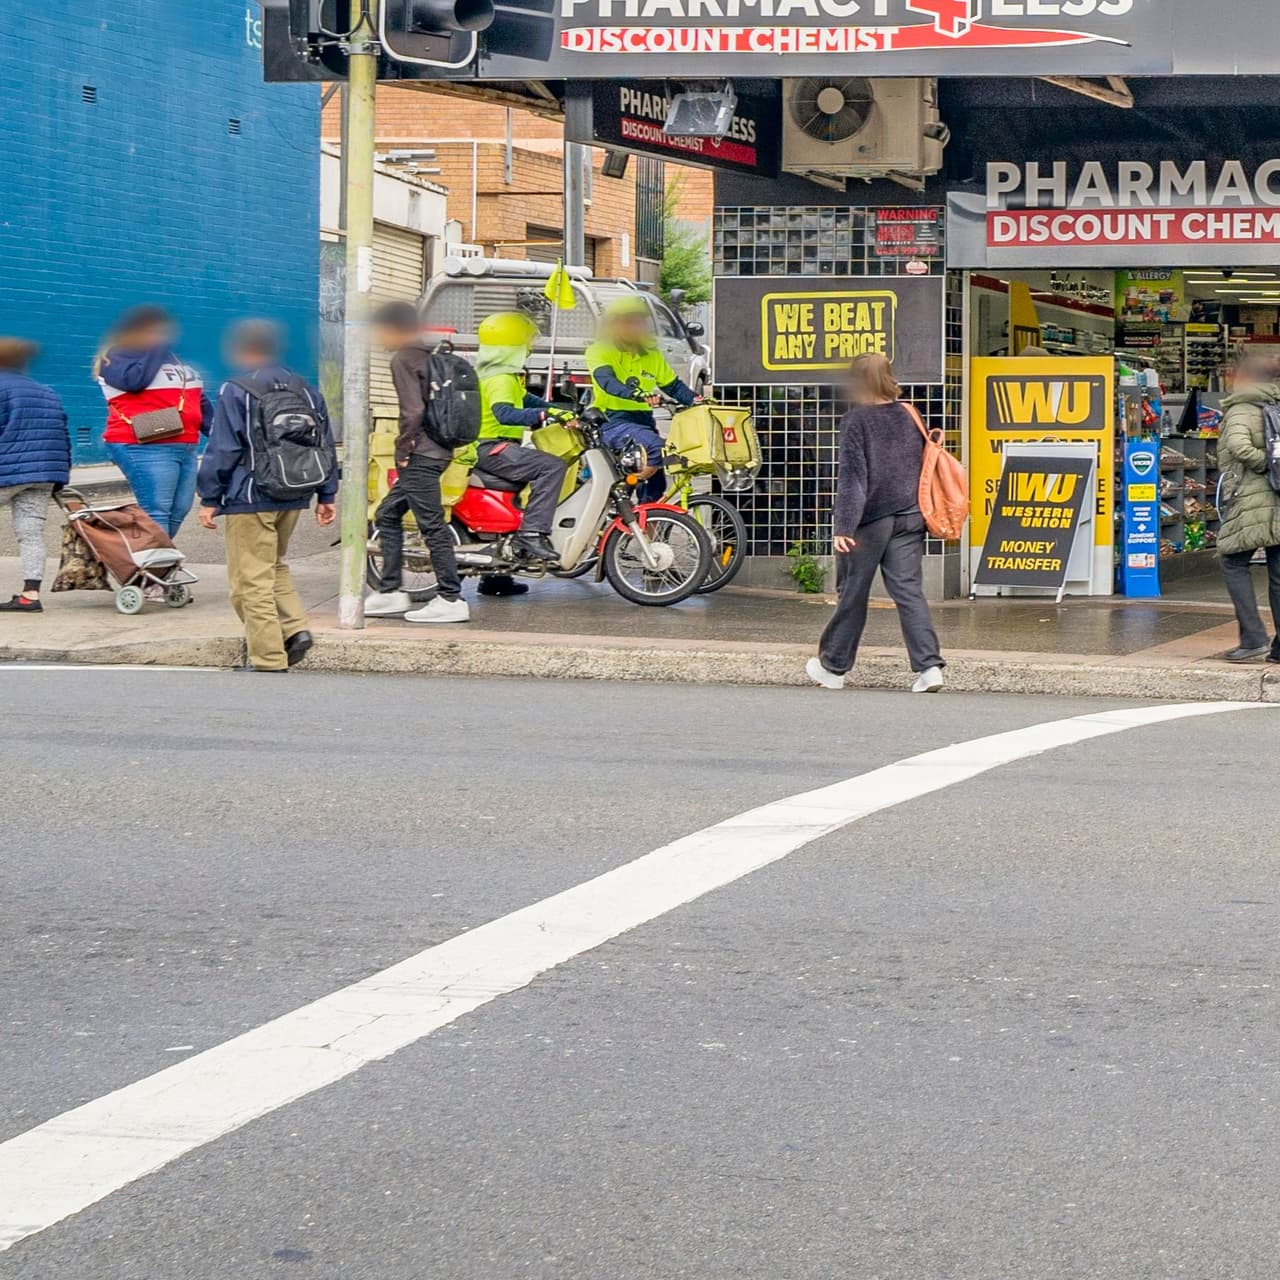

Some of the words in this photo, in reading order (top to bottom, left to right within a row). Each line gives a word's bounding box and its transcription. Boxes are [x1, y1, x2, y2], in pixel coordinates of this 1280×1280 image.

[567, 27, 750, 53] DISCOUNT
[753, 26, 901, 52] CHEMIST
[877, 208, 938, 220] WARNING
[992, 214, 1176, 244] DISCOUNT
[1138, 271, 1172, 280] ALLERGY
[773, 303, 814, 333] WE
[823, 301, 887, 333] BEAT
[773, 333, 818, 359] ANY
[824, 332, 887, 358] PRICE
[1001, 506, 1074, 518] WESTERN
[1020, 517, 1072, 528] UNION
[999, 540, 1055, 554] MONEY
[986, 556, 1062, 571] TRANSFER
